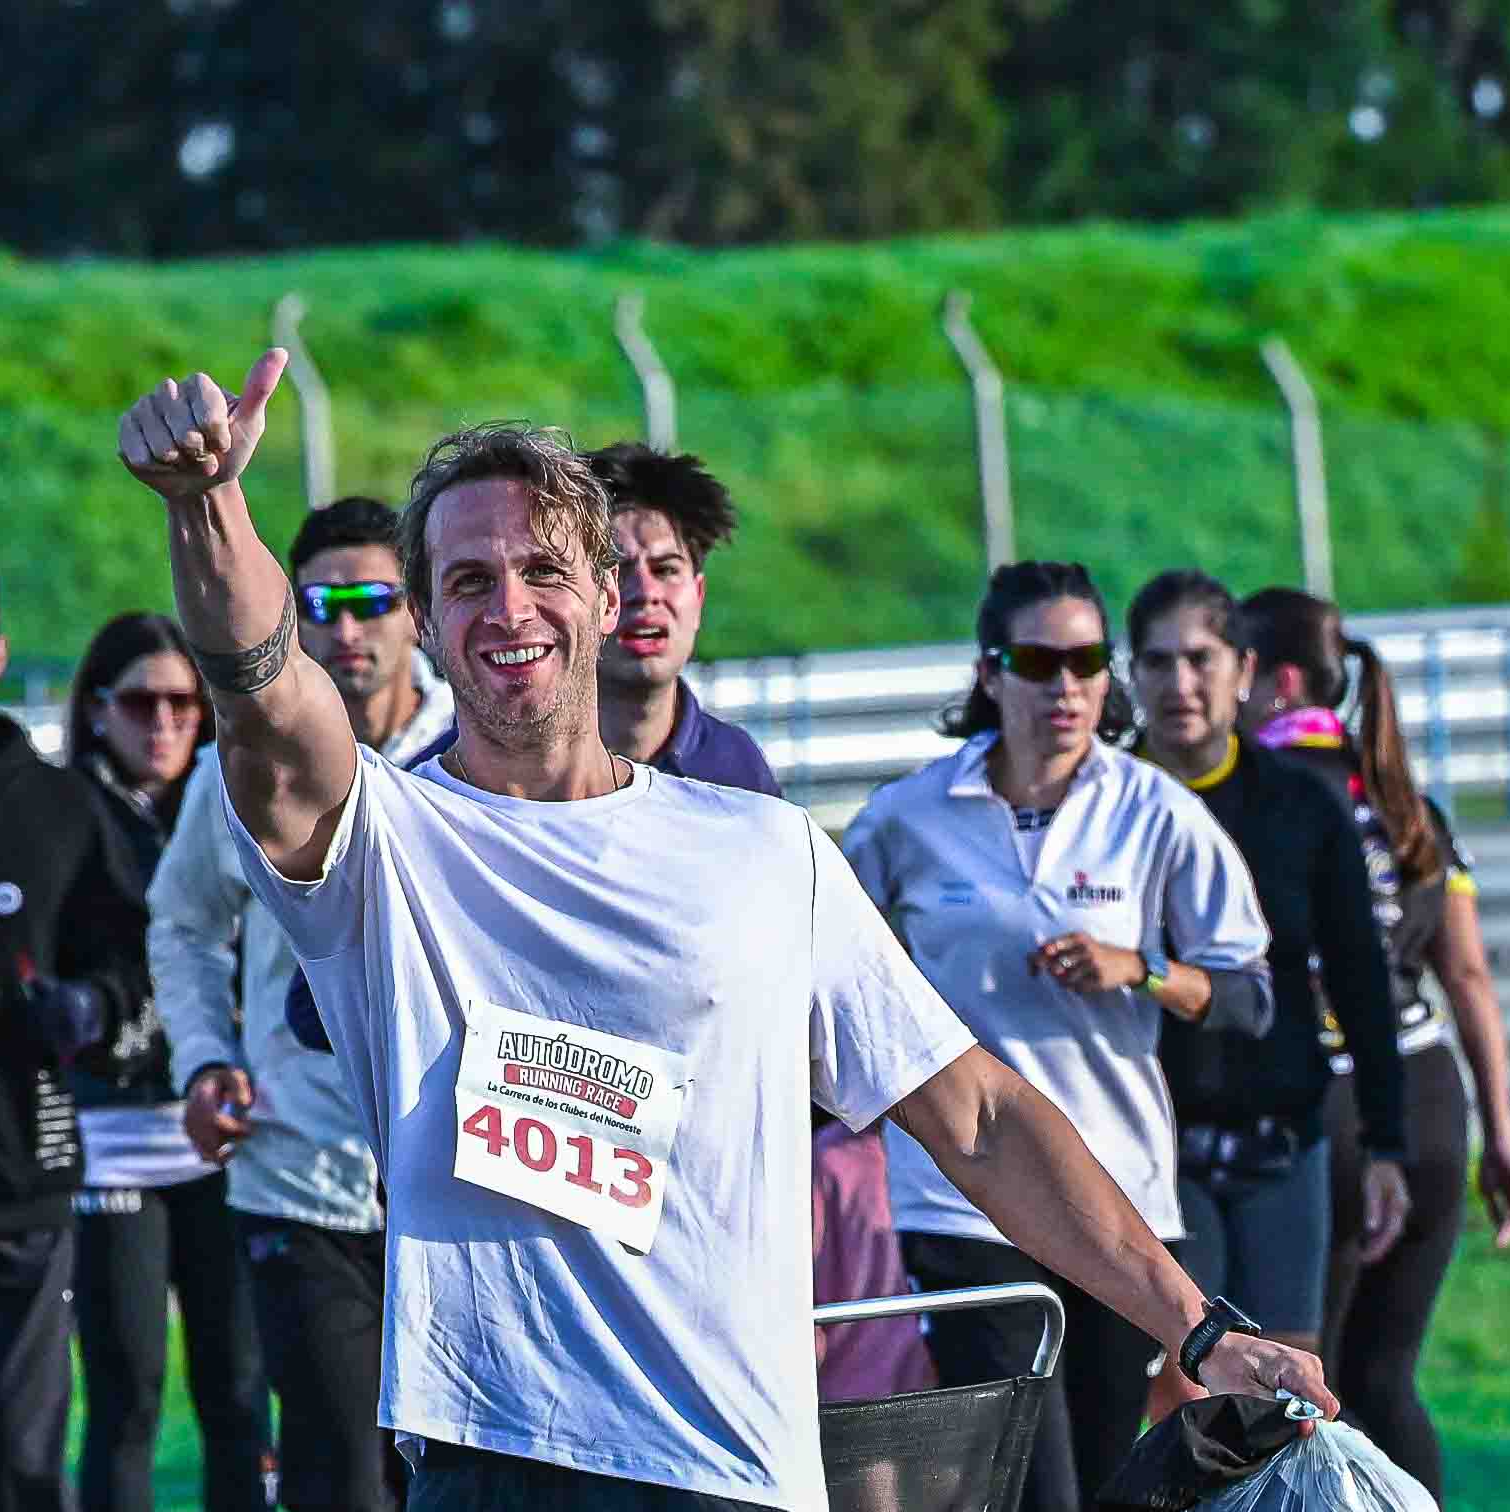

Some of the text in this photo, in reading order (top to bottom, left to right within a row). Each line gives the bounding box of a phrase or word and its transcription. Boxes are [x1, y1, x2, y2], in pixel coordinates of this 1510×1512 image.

[497, 1031, 654, 1100] AUTÓDROMO
[519, 1067, 622, 1112] RUNNING RACE
[487, 1081, 642, 1136] La Carrera de los Clubes del Noroeste
[463, 1104, 653, 1209] 4013
